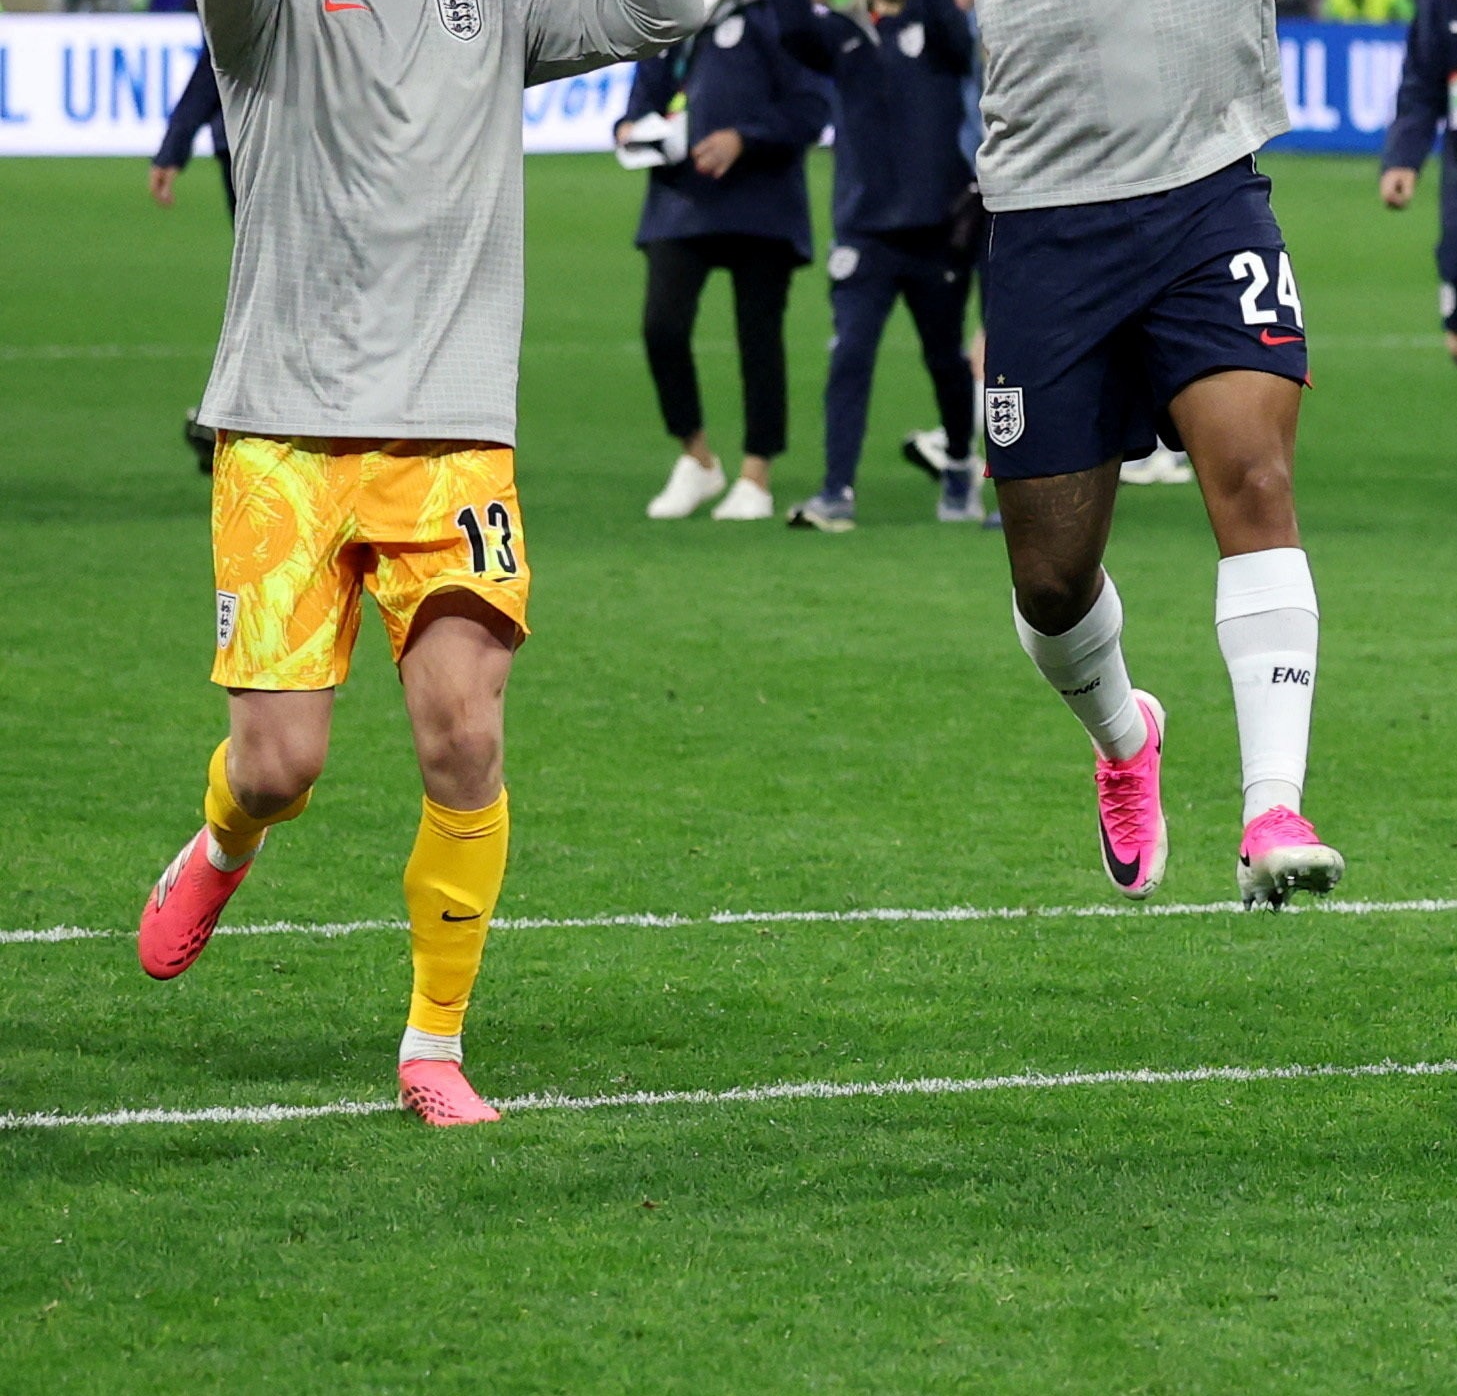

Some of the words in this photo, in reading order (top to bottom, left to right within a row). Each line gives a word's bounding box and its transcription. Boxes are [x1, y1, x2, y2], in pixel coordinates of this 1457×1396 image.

[1281, 39, 1341, 132] LL
[1229, 250, 1303, 329] 24
[457, 501, 517, 574] 13
[1272, 666, 1311, 687] ENG
